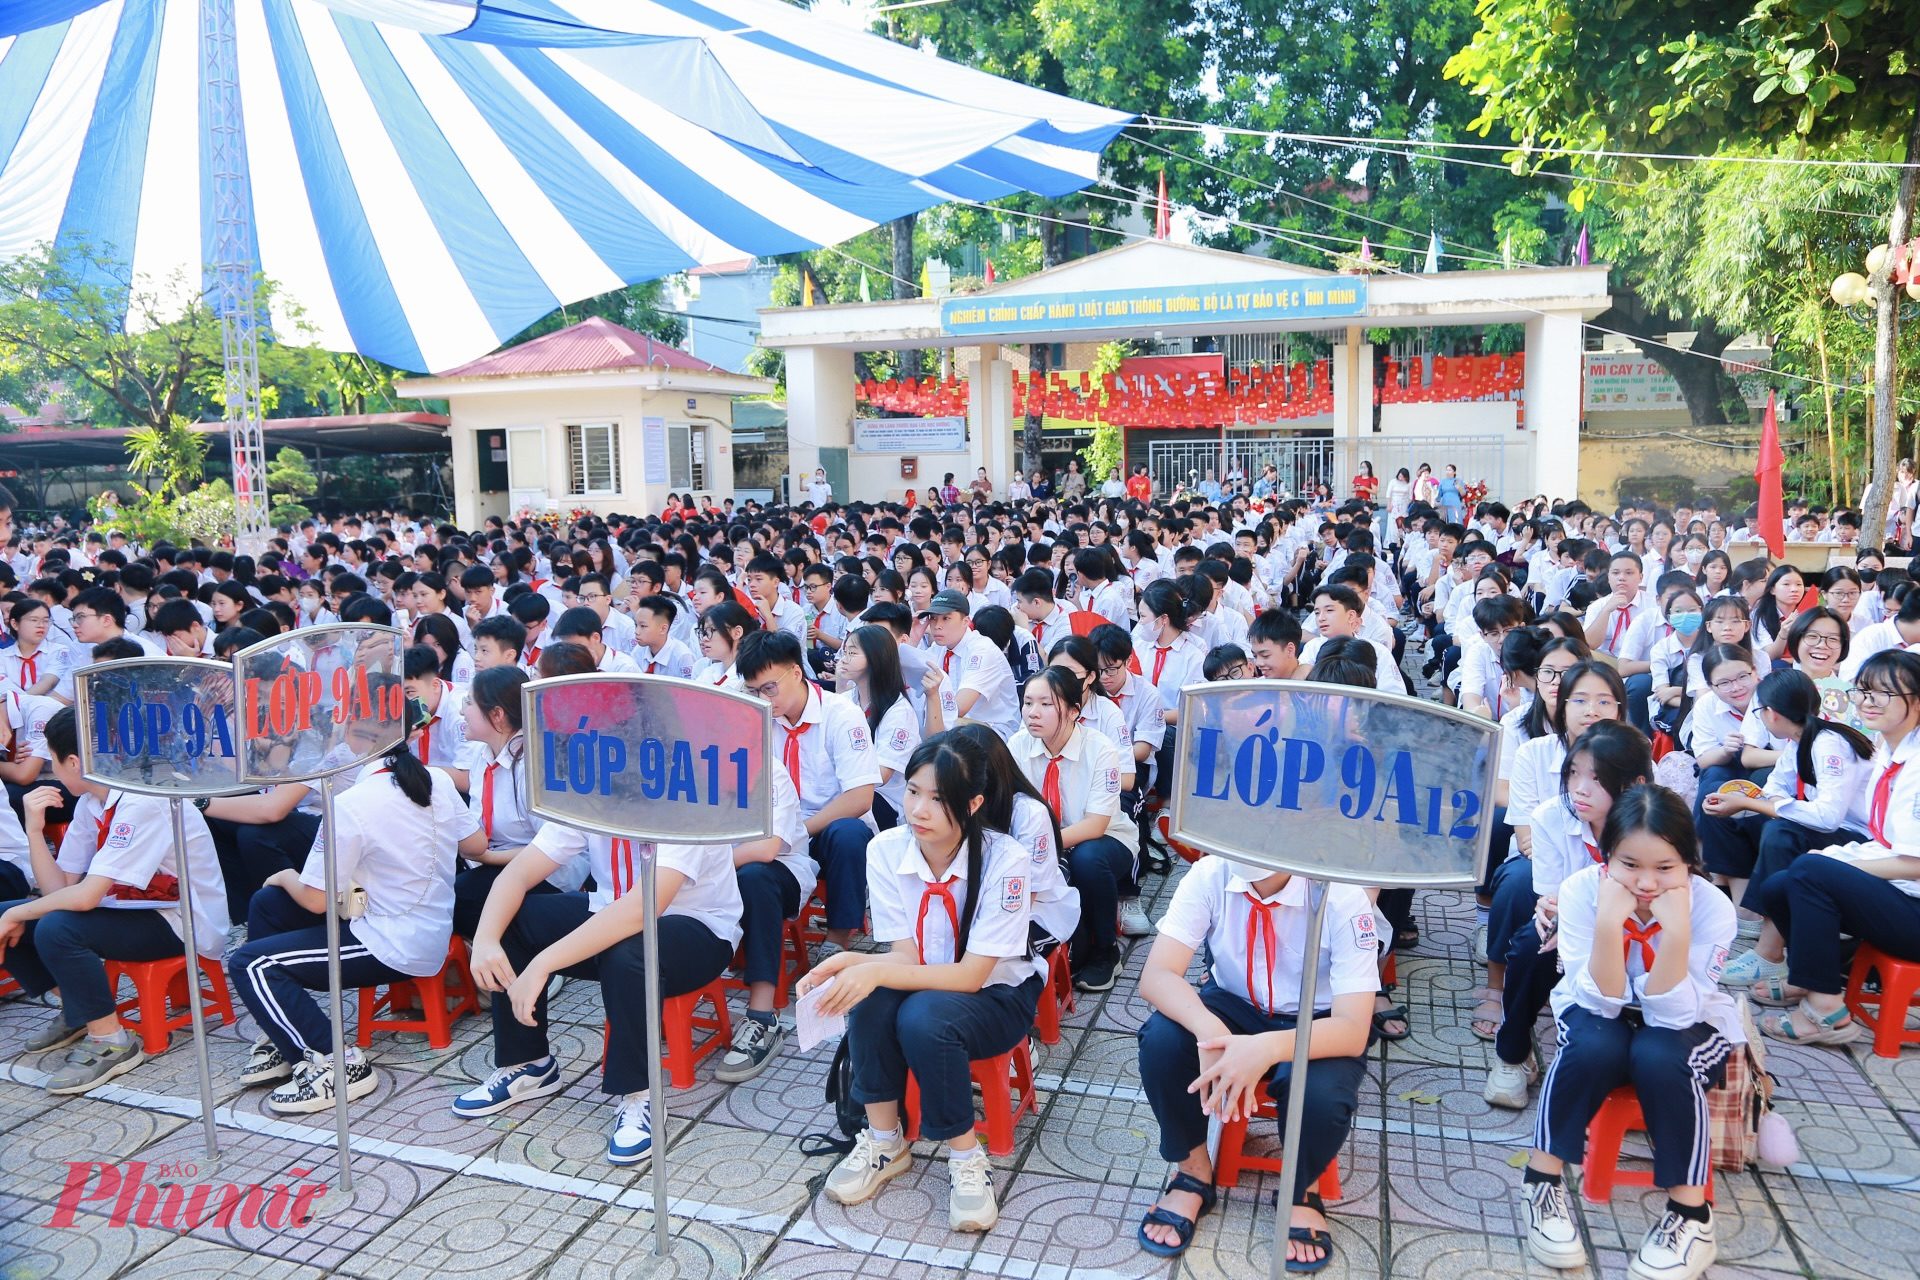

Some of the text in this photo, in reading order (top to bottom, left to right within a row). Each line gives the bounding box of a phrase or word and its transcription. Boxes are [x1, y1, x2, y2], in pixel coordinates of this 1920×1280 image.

[950, 306, 985, 324] NGHIÊM
[1021, 301, 1046, 320] CHẤP
[1049, 301, 1075, 319] HÀNH
[1079, 300, 1102, 319] LUẬT
[1105, 300, 1128, 316] GIAO
[1130, 296, 1162, 314] THÔNG
[1166, 294, 1200, 313] ĐƯỜNG
[1204, 292, 1218, 313] BỘ
[1220, 292, 1233, 310] LÀ
[1236, 292, 1250, 312] TỰ
[1253, 288, 1273, 309] BẢO
[1276, 289, 1289, 310] VỆ
[1328, 287, 1356, 304] MÌNH
[1590, 363, 1606, 376] MÌ
[1610, 364, 1633, 376] CAY
[1637, 364, 1645, 375] 7
[95, 682, 171, 757] LỚP
[244, 655, 403, 740] LỚP 9A10
[543, 716, 748, 809] LỚP 9A11
[1192, 709, 1480, 840] LỚP 9A12
